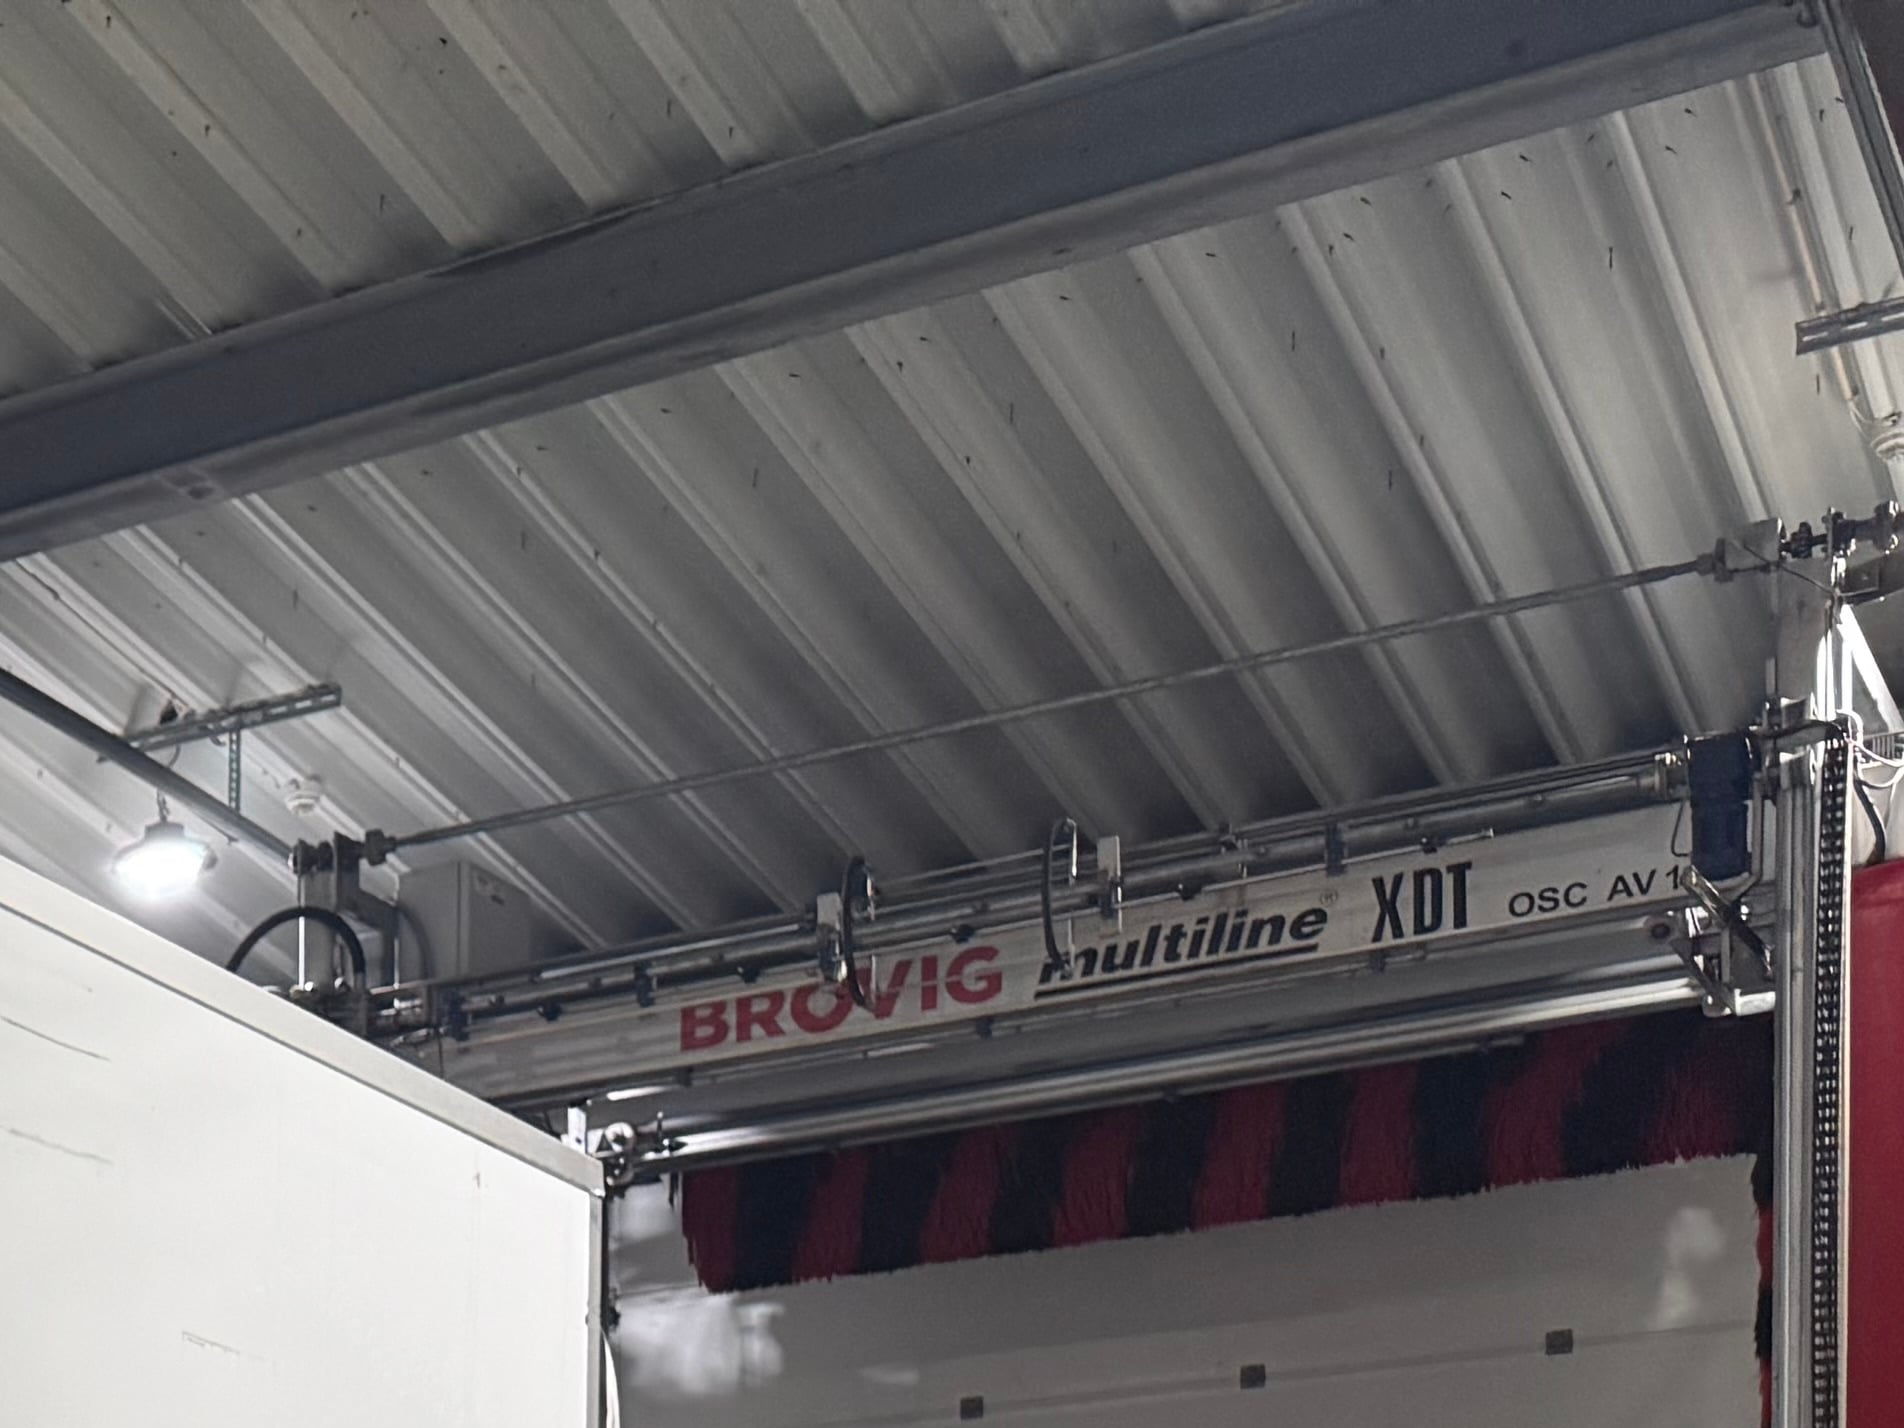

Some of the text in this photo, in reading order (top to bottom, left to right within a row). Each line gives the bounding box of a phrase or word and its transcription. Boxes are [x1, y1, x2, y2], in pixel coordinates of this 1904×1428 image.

[1371, 861, 1472, 943] XDT
[1508, 881, 1588, 918] OSC
[1607, 868, 1657, 901] AV
